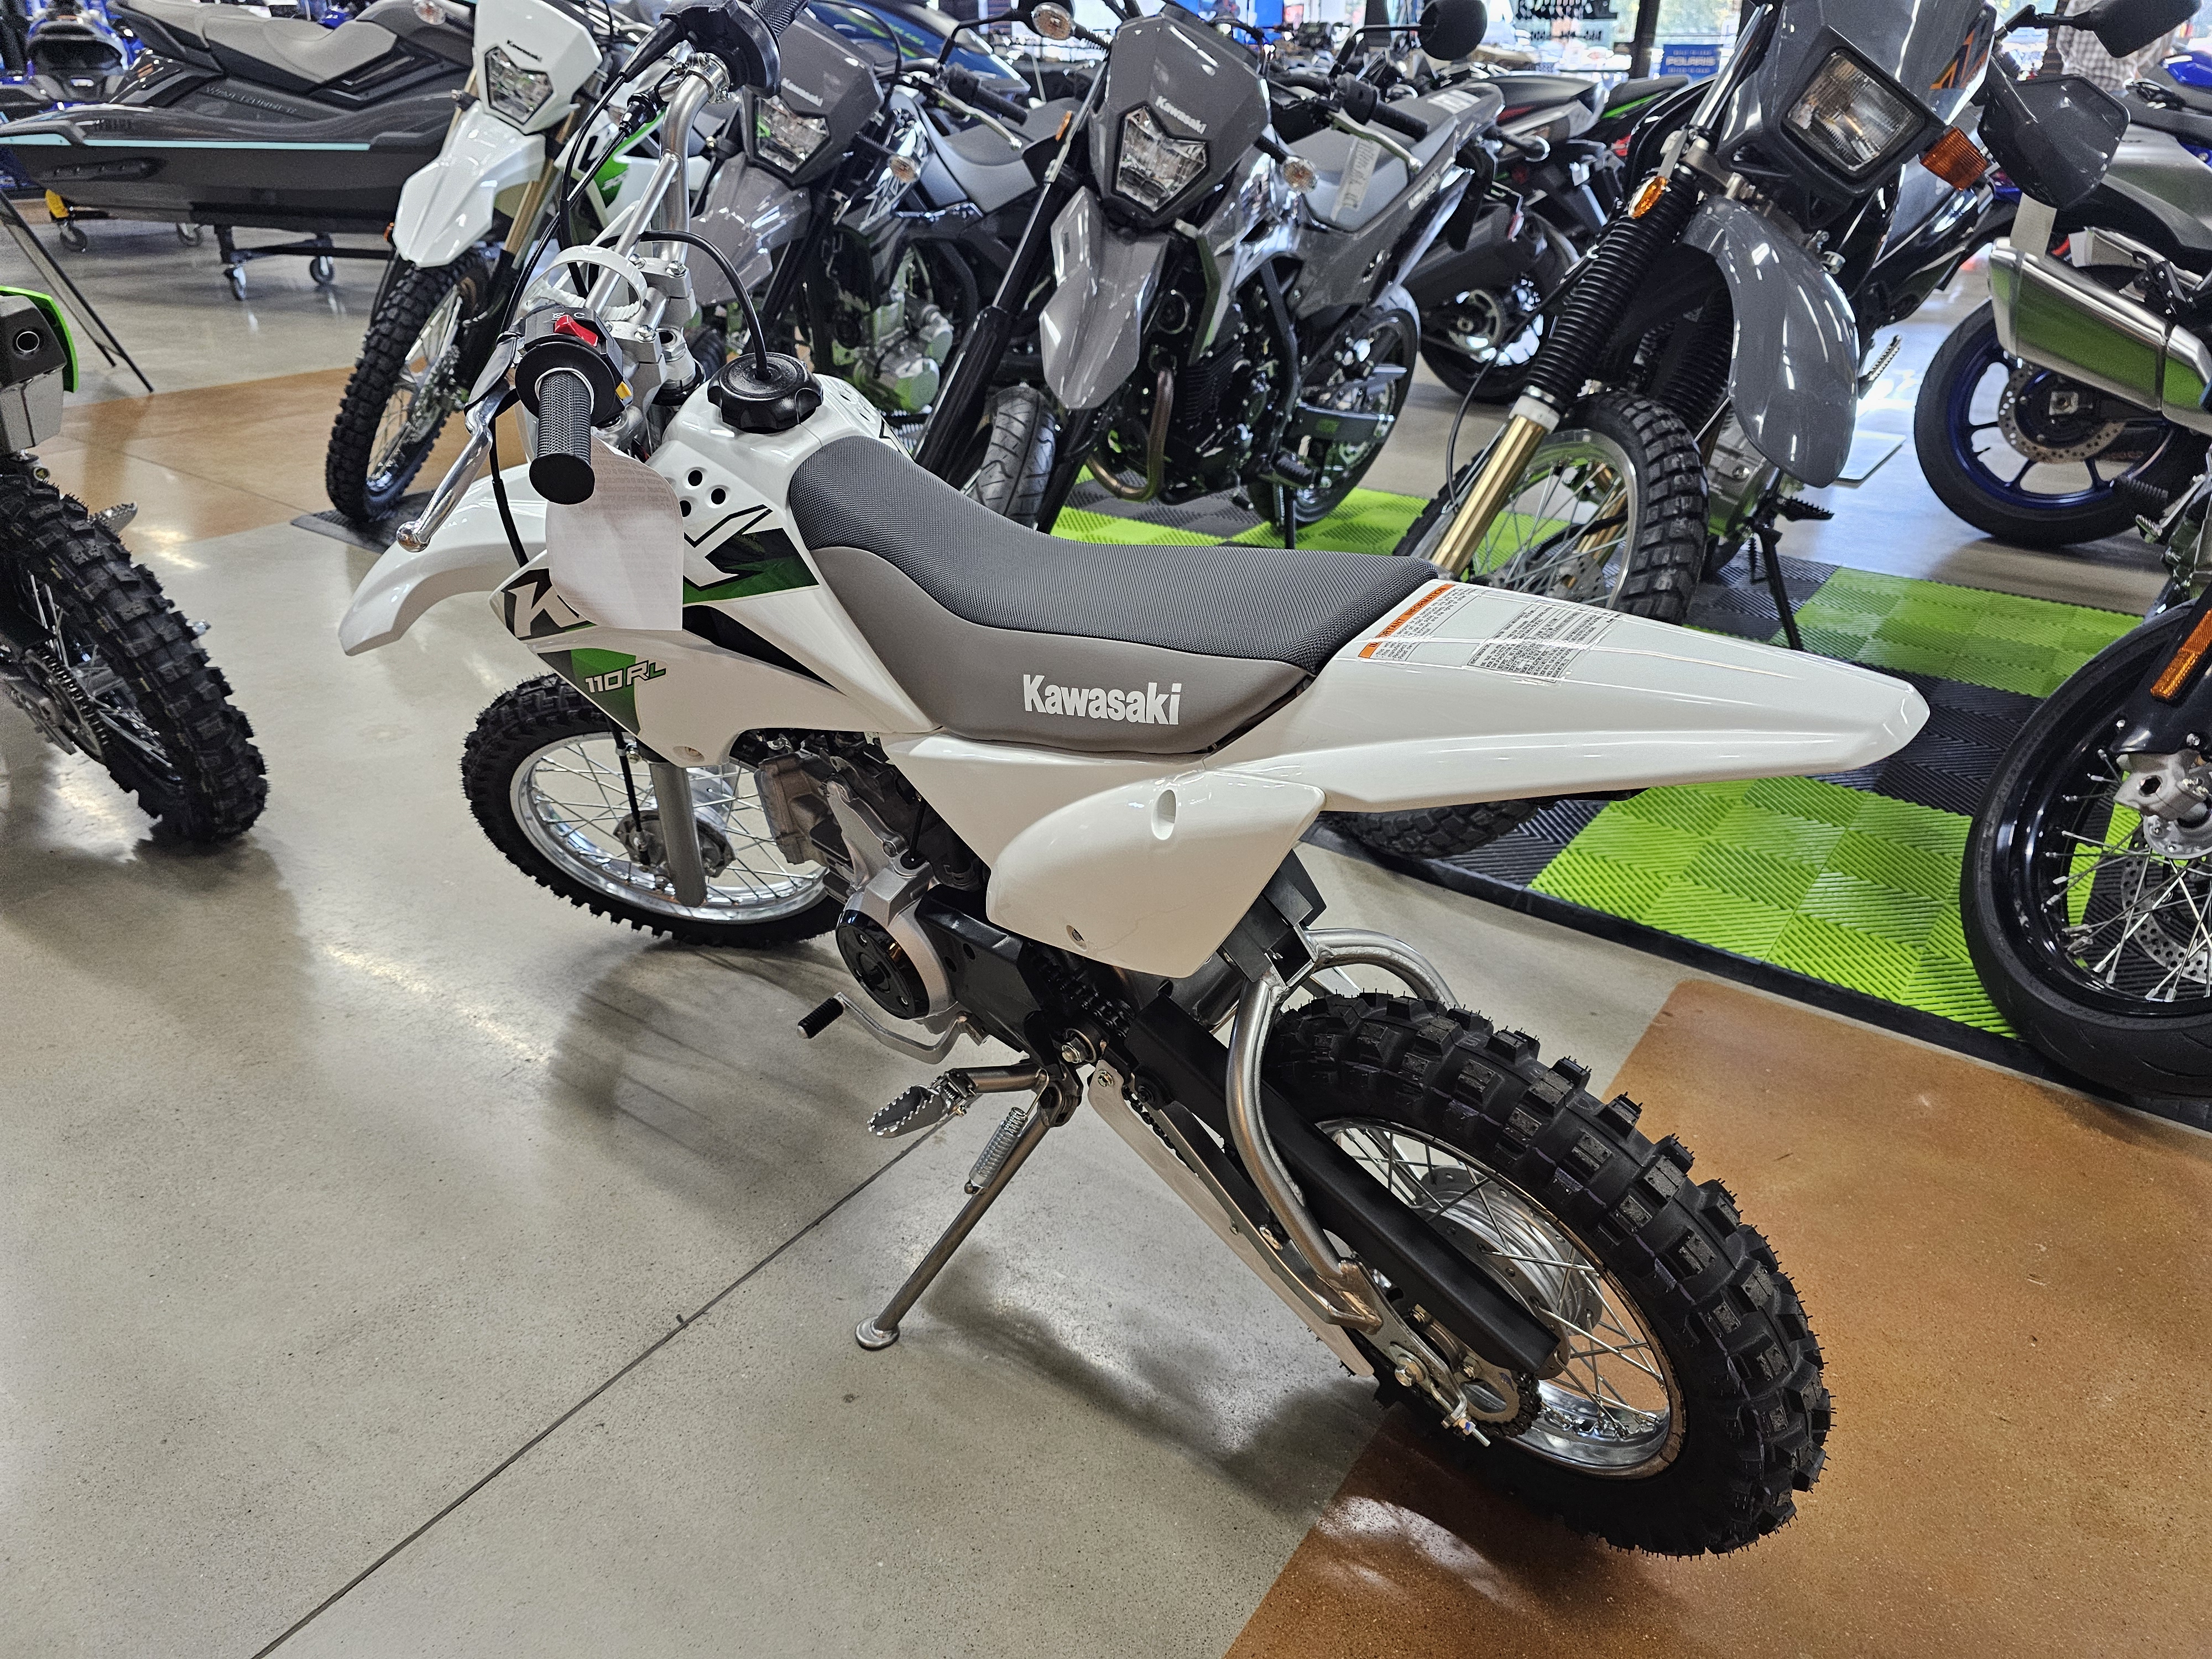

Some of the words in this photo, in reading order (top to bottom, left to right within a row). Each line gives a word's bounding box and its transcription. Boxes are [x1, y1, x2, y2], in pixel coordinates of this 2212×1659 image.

[1155, 95, 1207, 134] Kawasaki
[1369, 618, 1405, 648] IORTANT
[1404, 587, 1447, 616] INFORMATION
[1023, 674, 1182, 725] Kawasaki
